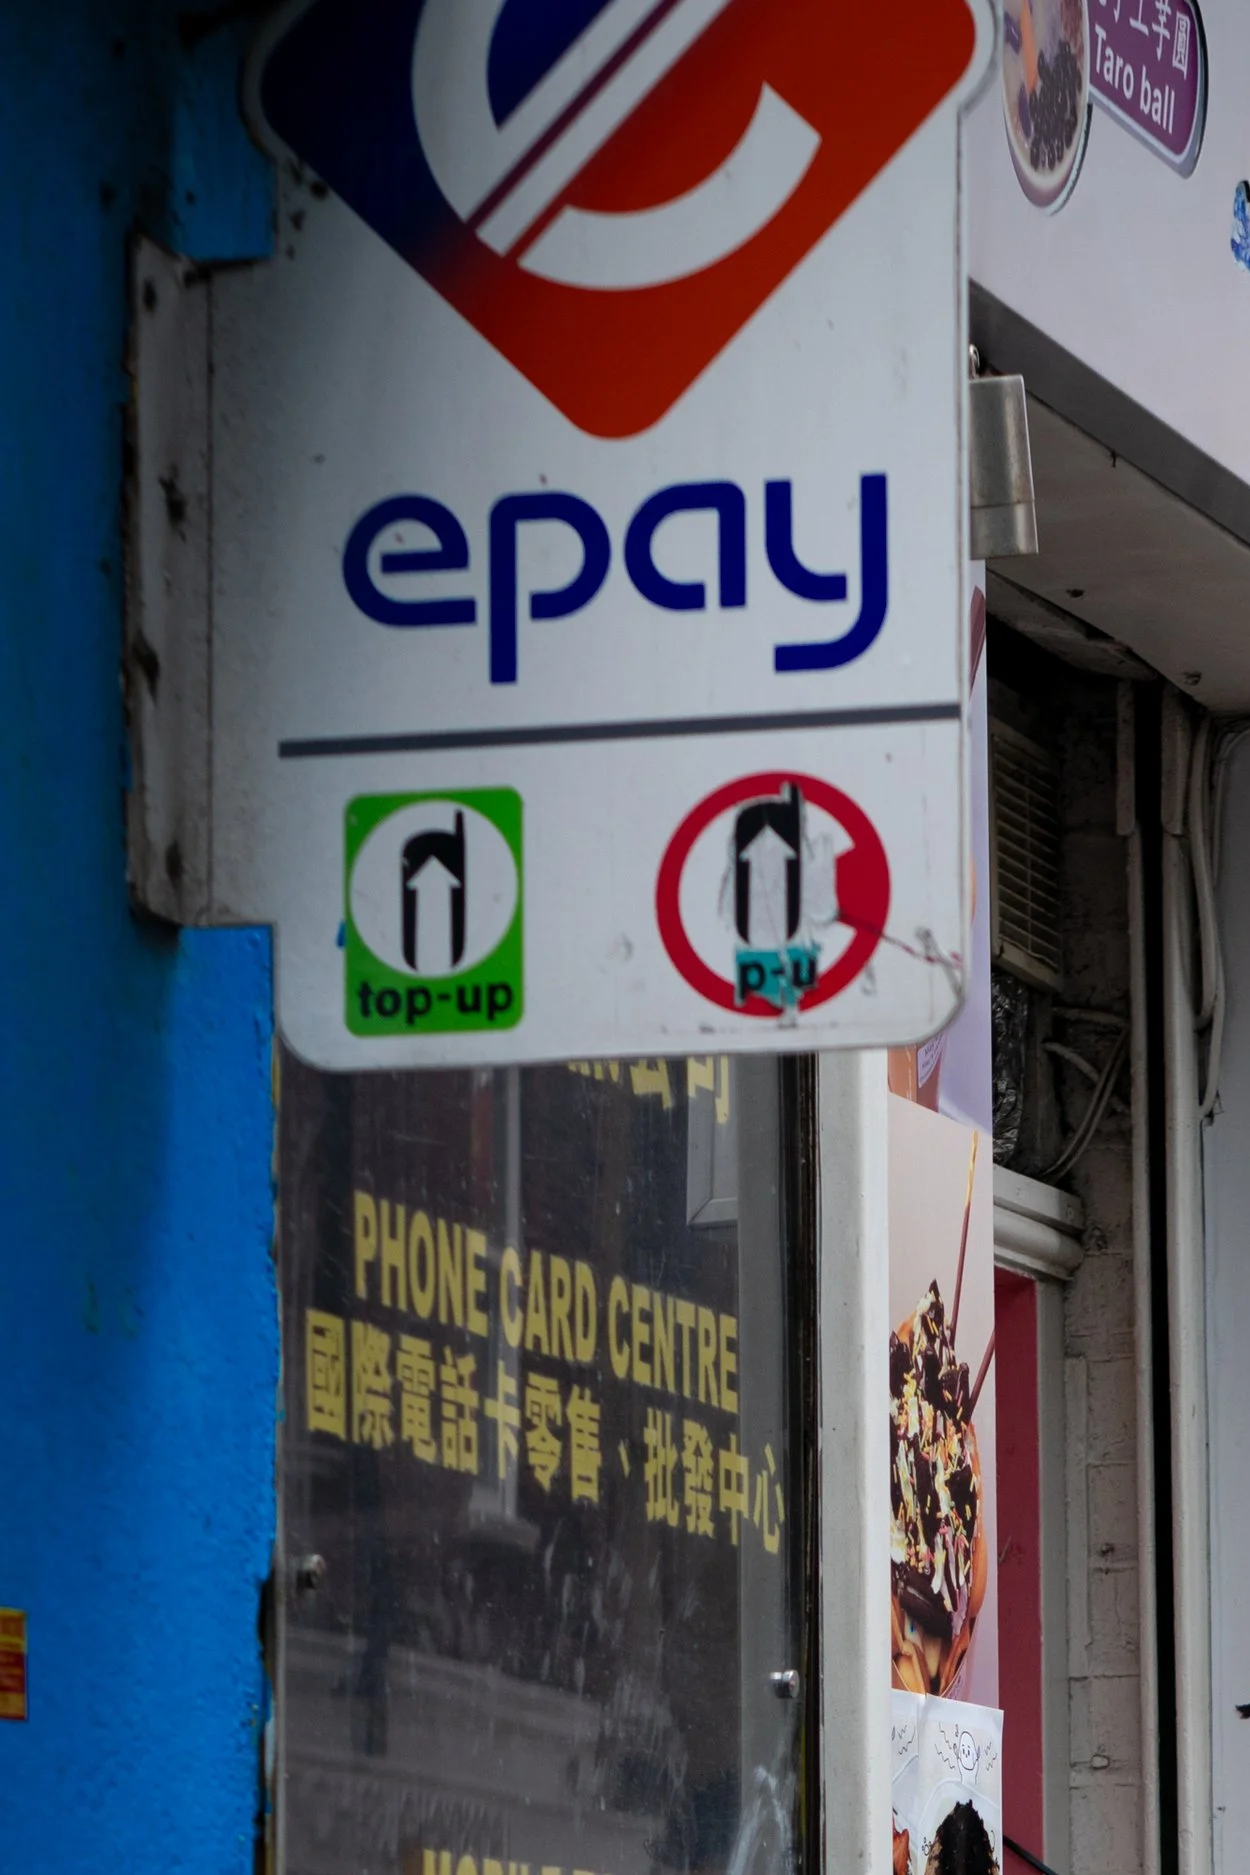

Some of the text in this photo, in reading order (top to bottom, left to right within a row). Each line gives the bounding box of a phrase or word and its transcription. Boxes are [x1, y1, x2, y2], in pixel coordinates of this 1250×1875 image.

[1095, 24, 1175, 134] Taro ball
[342, 472, 888, 685] epay
[357, 979, 515, 1026] top-up
[354, 1189, 739, 1416] PHONE CARD CENTRE
